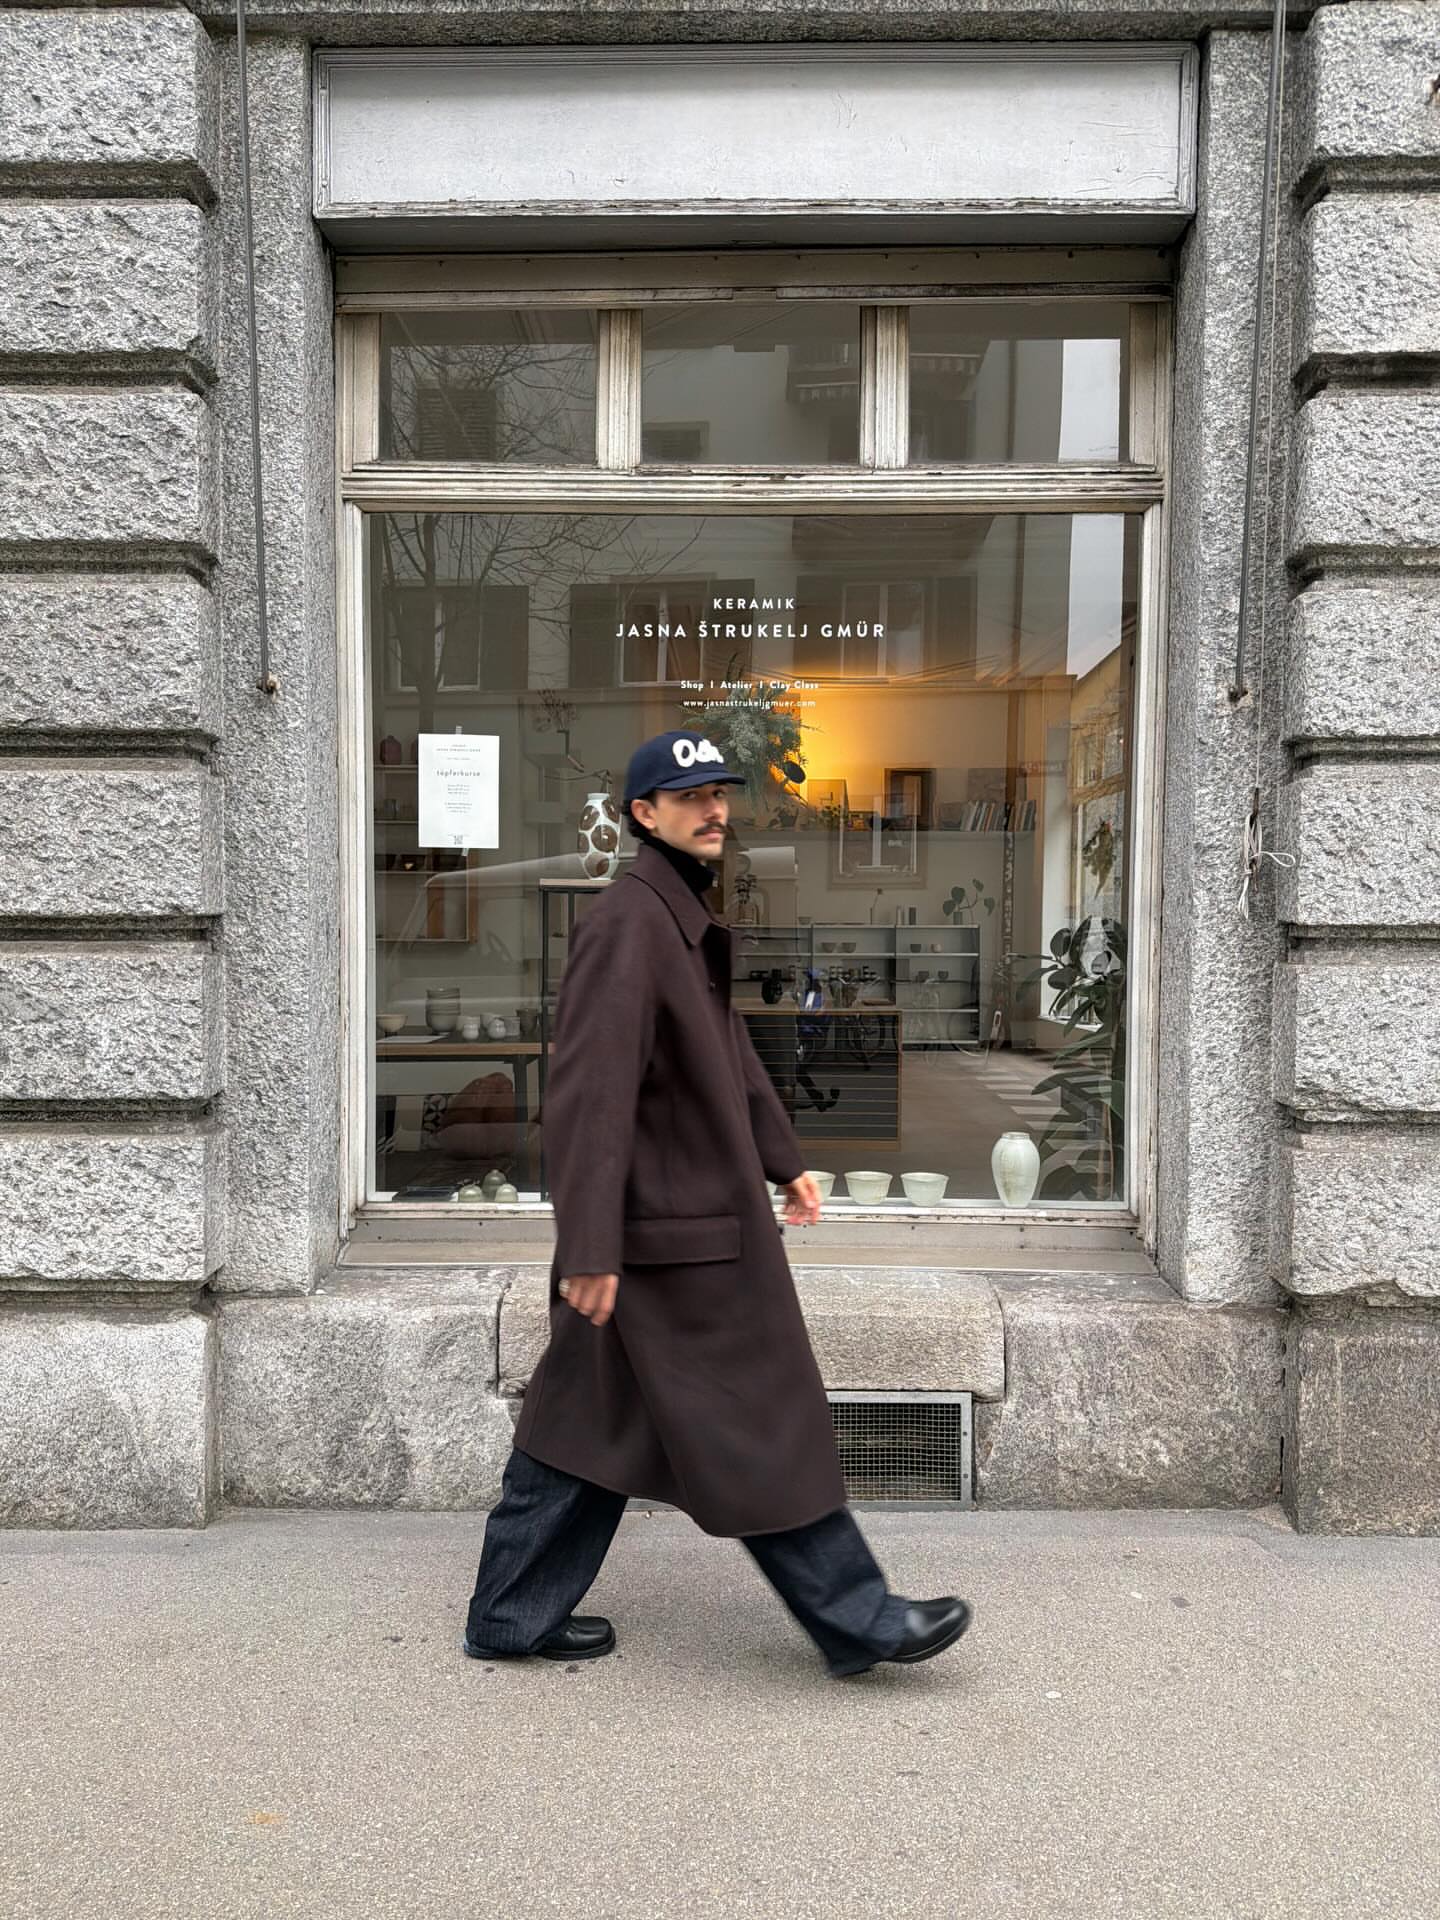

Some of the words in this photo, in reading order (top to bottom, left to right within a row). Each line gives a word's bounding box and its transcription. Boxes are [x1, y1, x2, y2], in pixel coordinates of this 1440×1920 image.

[713, 597, 794, 610] KERAMIK
[615, 623, 687, 639] JASNA
[698, 620, 808, 638] ŠTRUKELJ
[820, 620, 885, 638] GMÜR
[680, 680, 704, 693] Shop
[719, 680, 753, 690] Atelier
[769, 680, 791, 693] Clay
[794, 680, 819, 690] Class
[682, 698, 817, 710] www.jasnastrukeljgmuer.com
